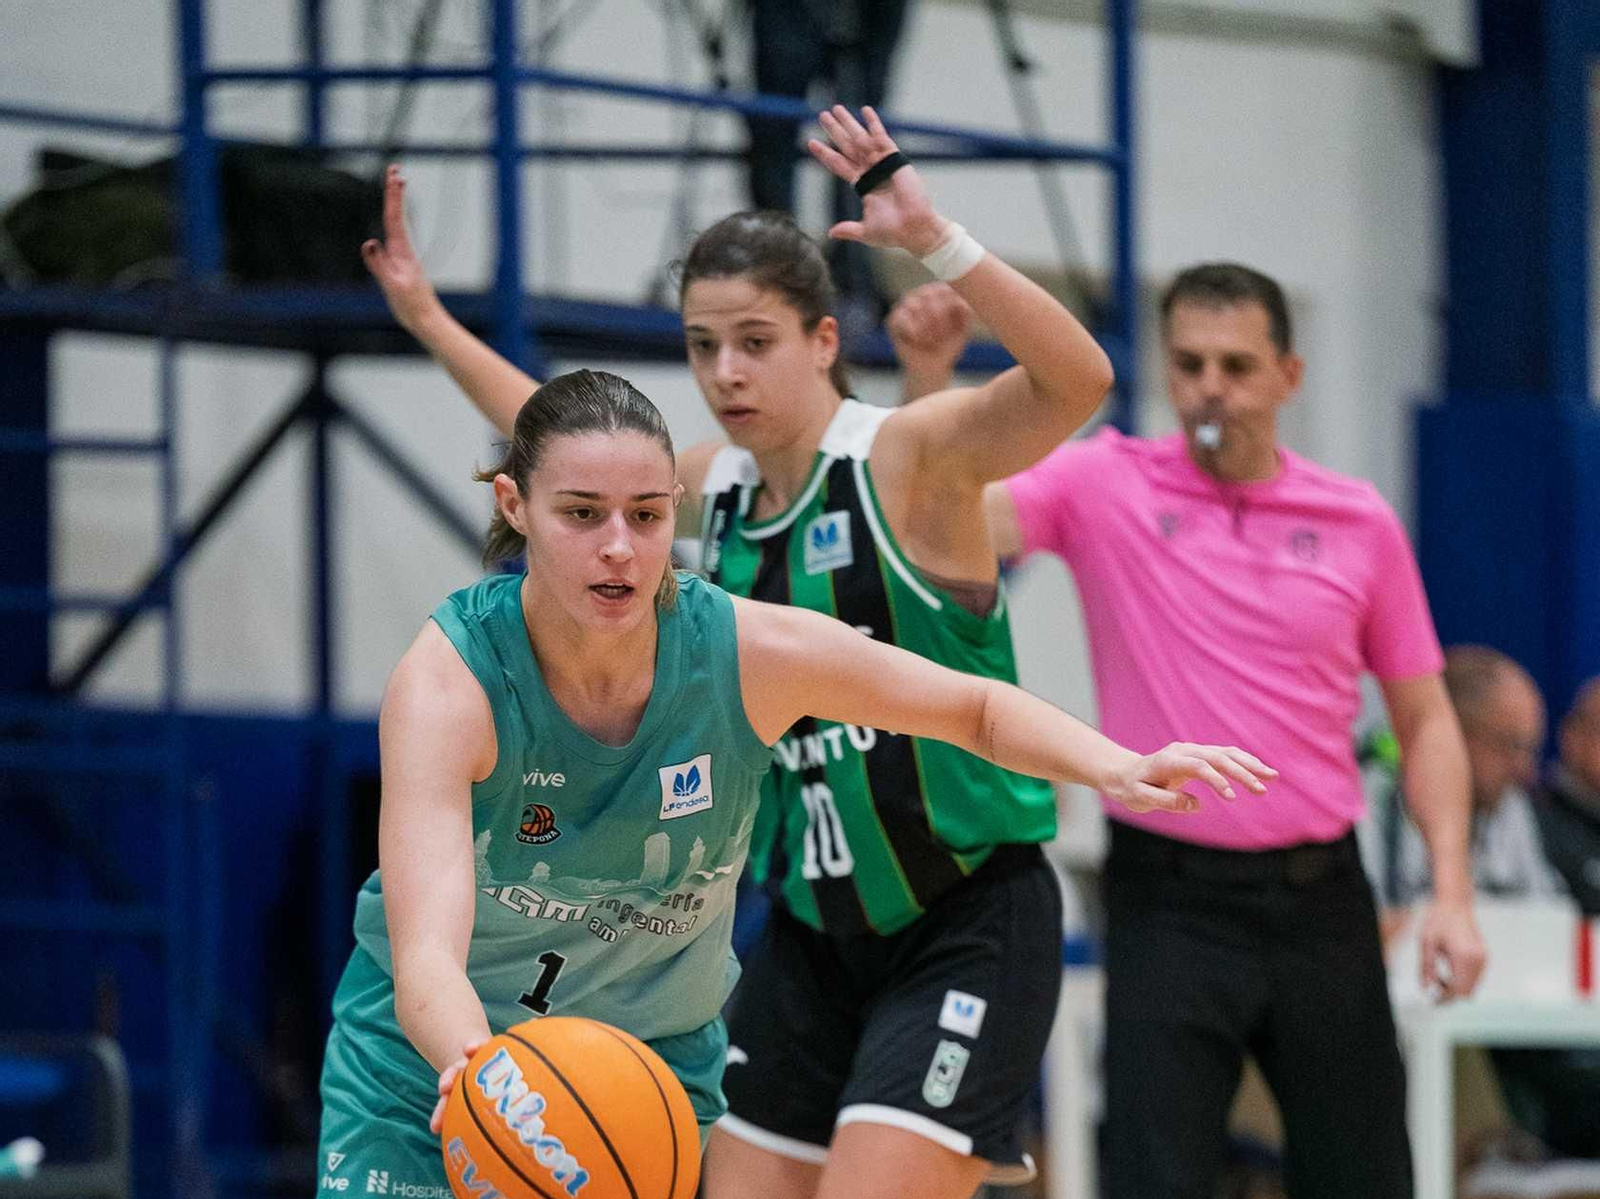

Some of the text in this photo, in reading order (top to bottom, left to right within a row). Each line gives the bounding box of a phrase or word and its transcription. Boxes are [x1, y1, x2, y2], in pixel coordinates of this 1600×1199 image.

[523, 769, 566, 787] vive
[801, 782, 855, 879] 10
[518, 951, 568, 1015] 1
[476, 1047, 590, 1197] Wilson
[321, 1173, 349, 1191] ive
